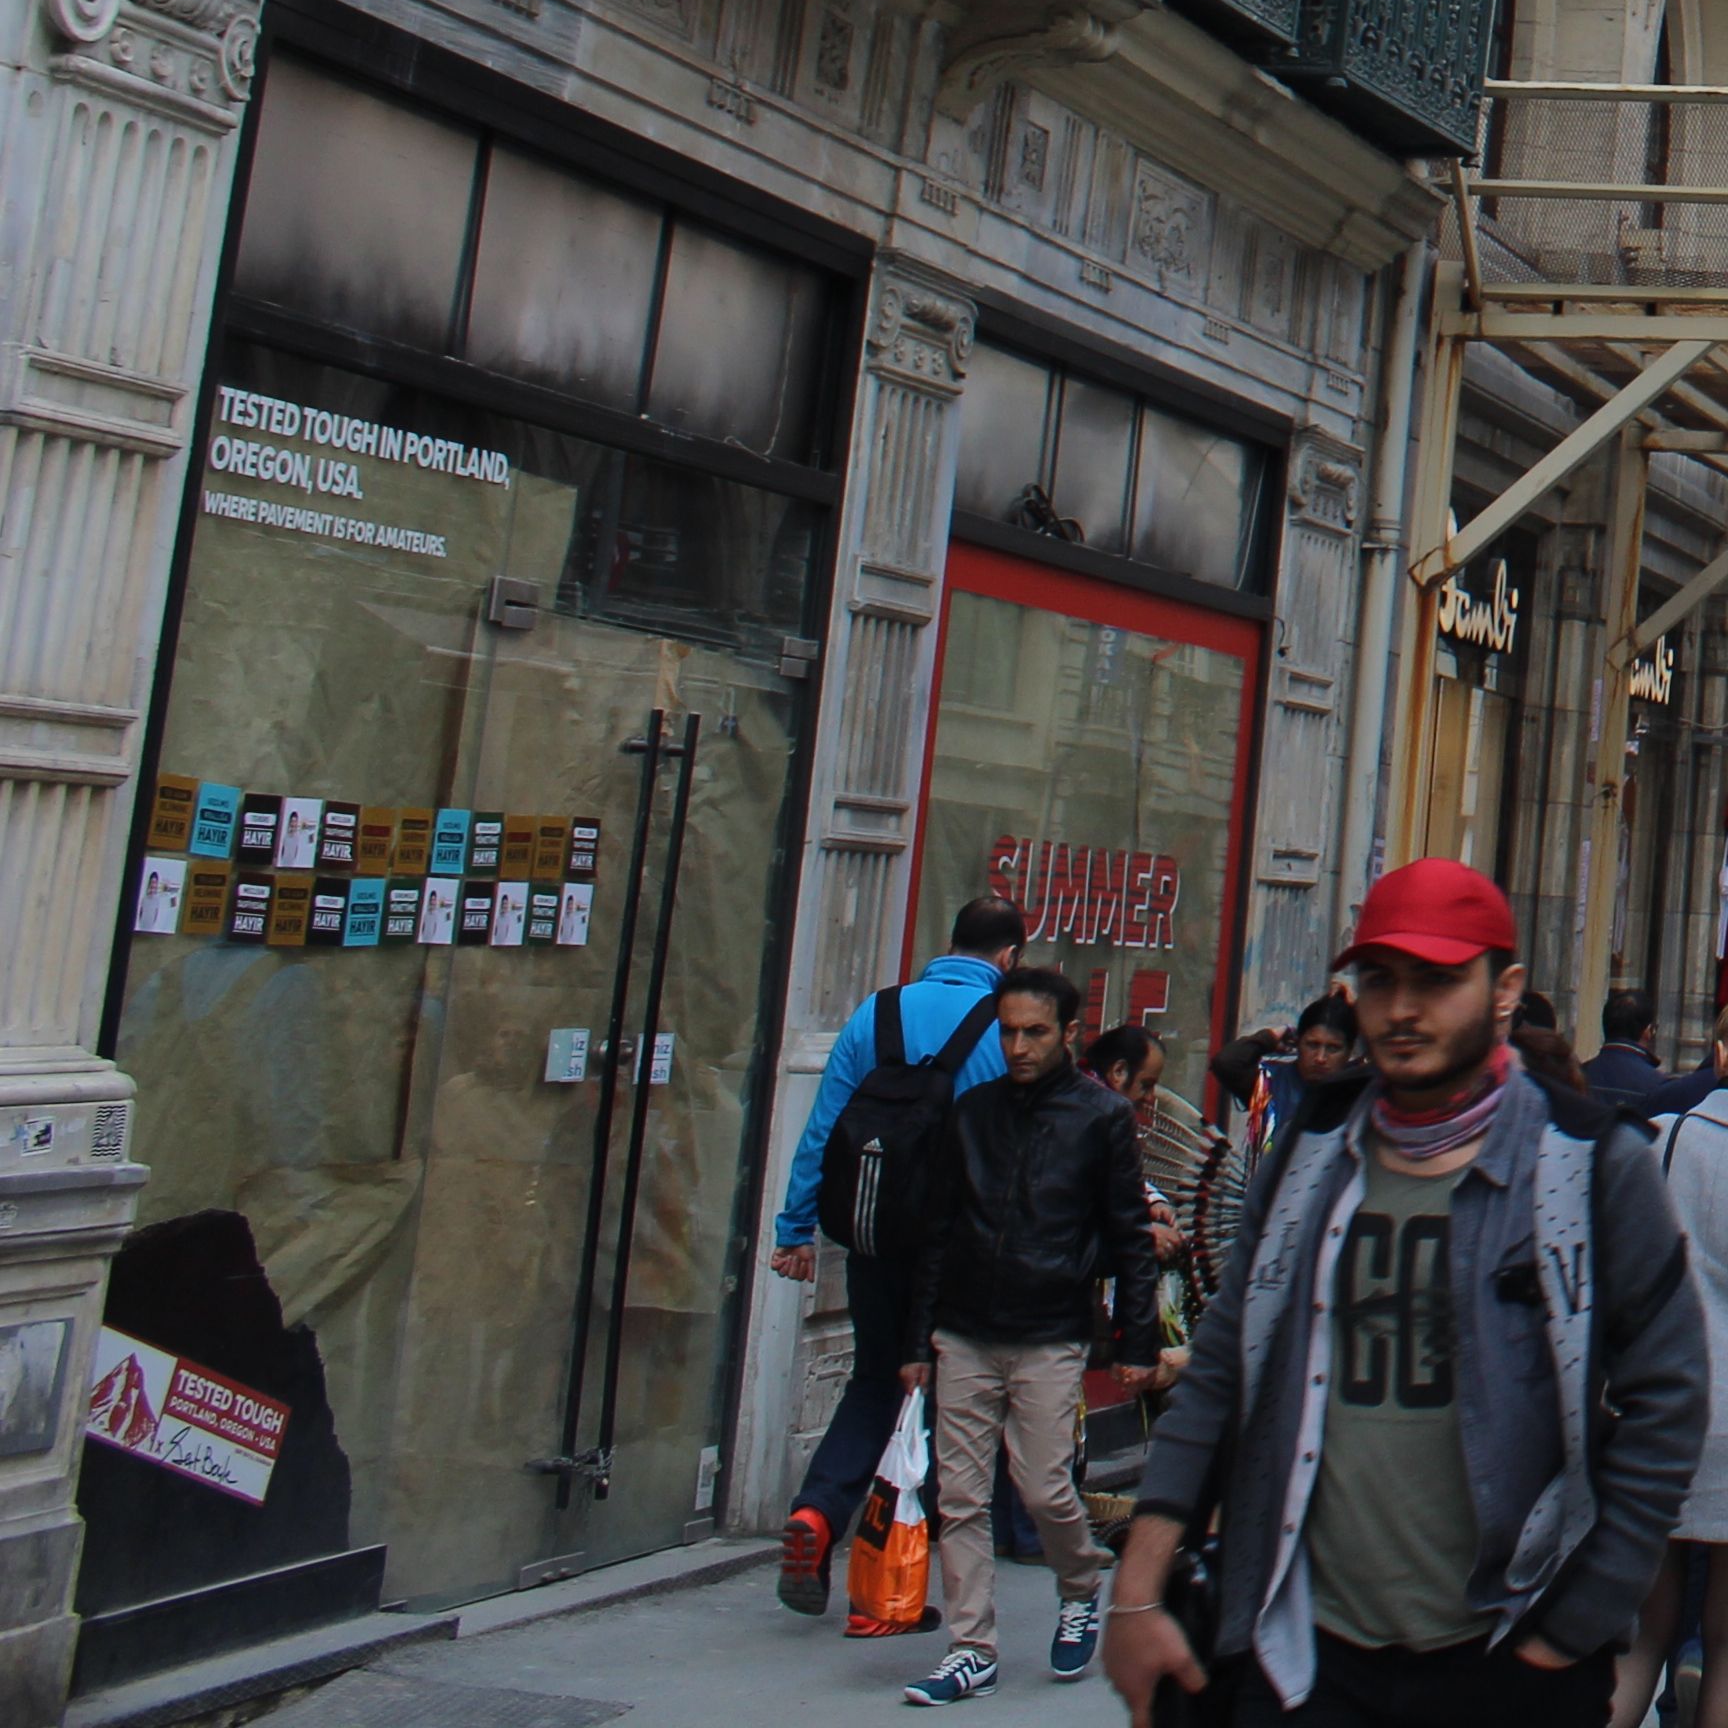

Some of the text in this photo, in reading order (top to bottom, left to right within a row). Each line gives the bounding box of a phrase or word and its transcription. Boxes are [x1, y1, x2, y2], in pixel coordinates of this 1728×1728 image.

[219, 385, 511, 490] TESTED TOUGH IN PORTLAND,
[210, 436, 364, 500] OREGON, USA.
[204, 489, 448, 558] WHERE PAVEMENT IS FOR AMATEURS.
[198, 827, 229, 846] HAYIR
[242, 830, 273, 847] HAYIR
[322, 842, 354, 860] HAYIR
[987, 834, 1182, 950] SUMMER
[234, 914, 264, 933] HAYIR
[313, 912, 341, 928] HAYIR
[386, 919, 414, 932] HAYIR
[177, 1368, 286, 1434] TESTED TOUGH
[168, 1396, 277, 1451] PORTLAND, OREGON USA
